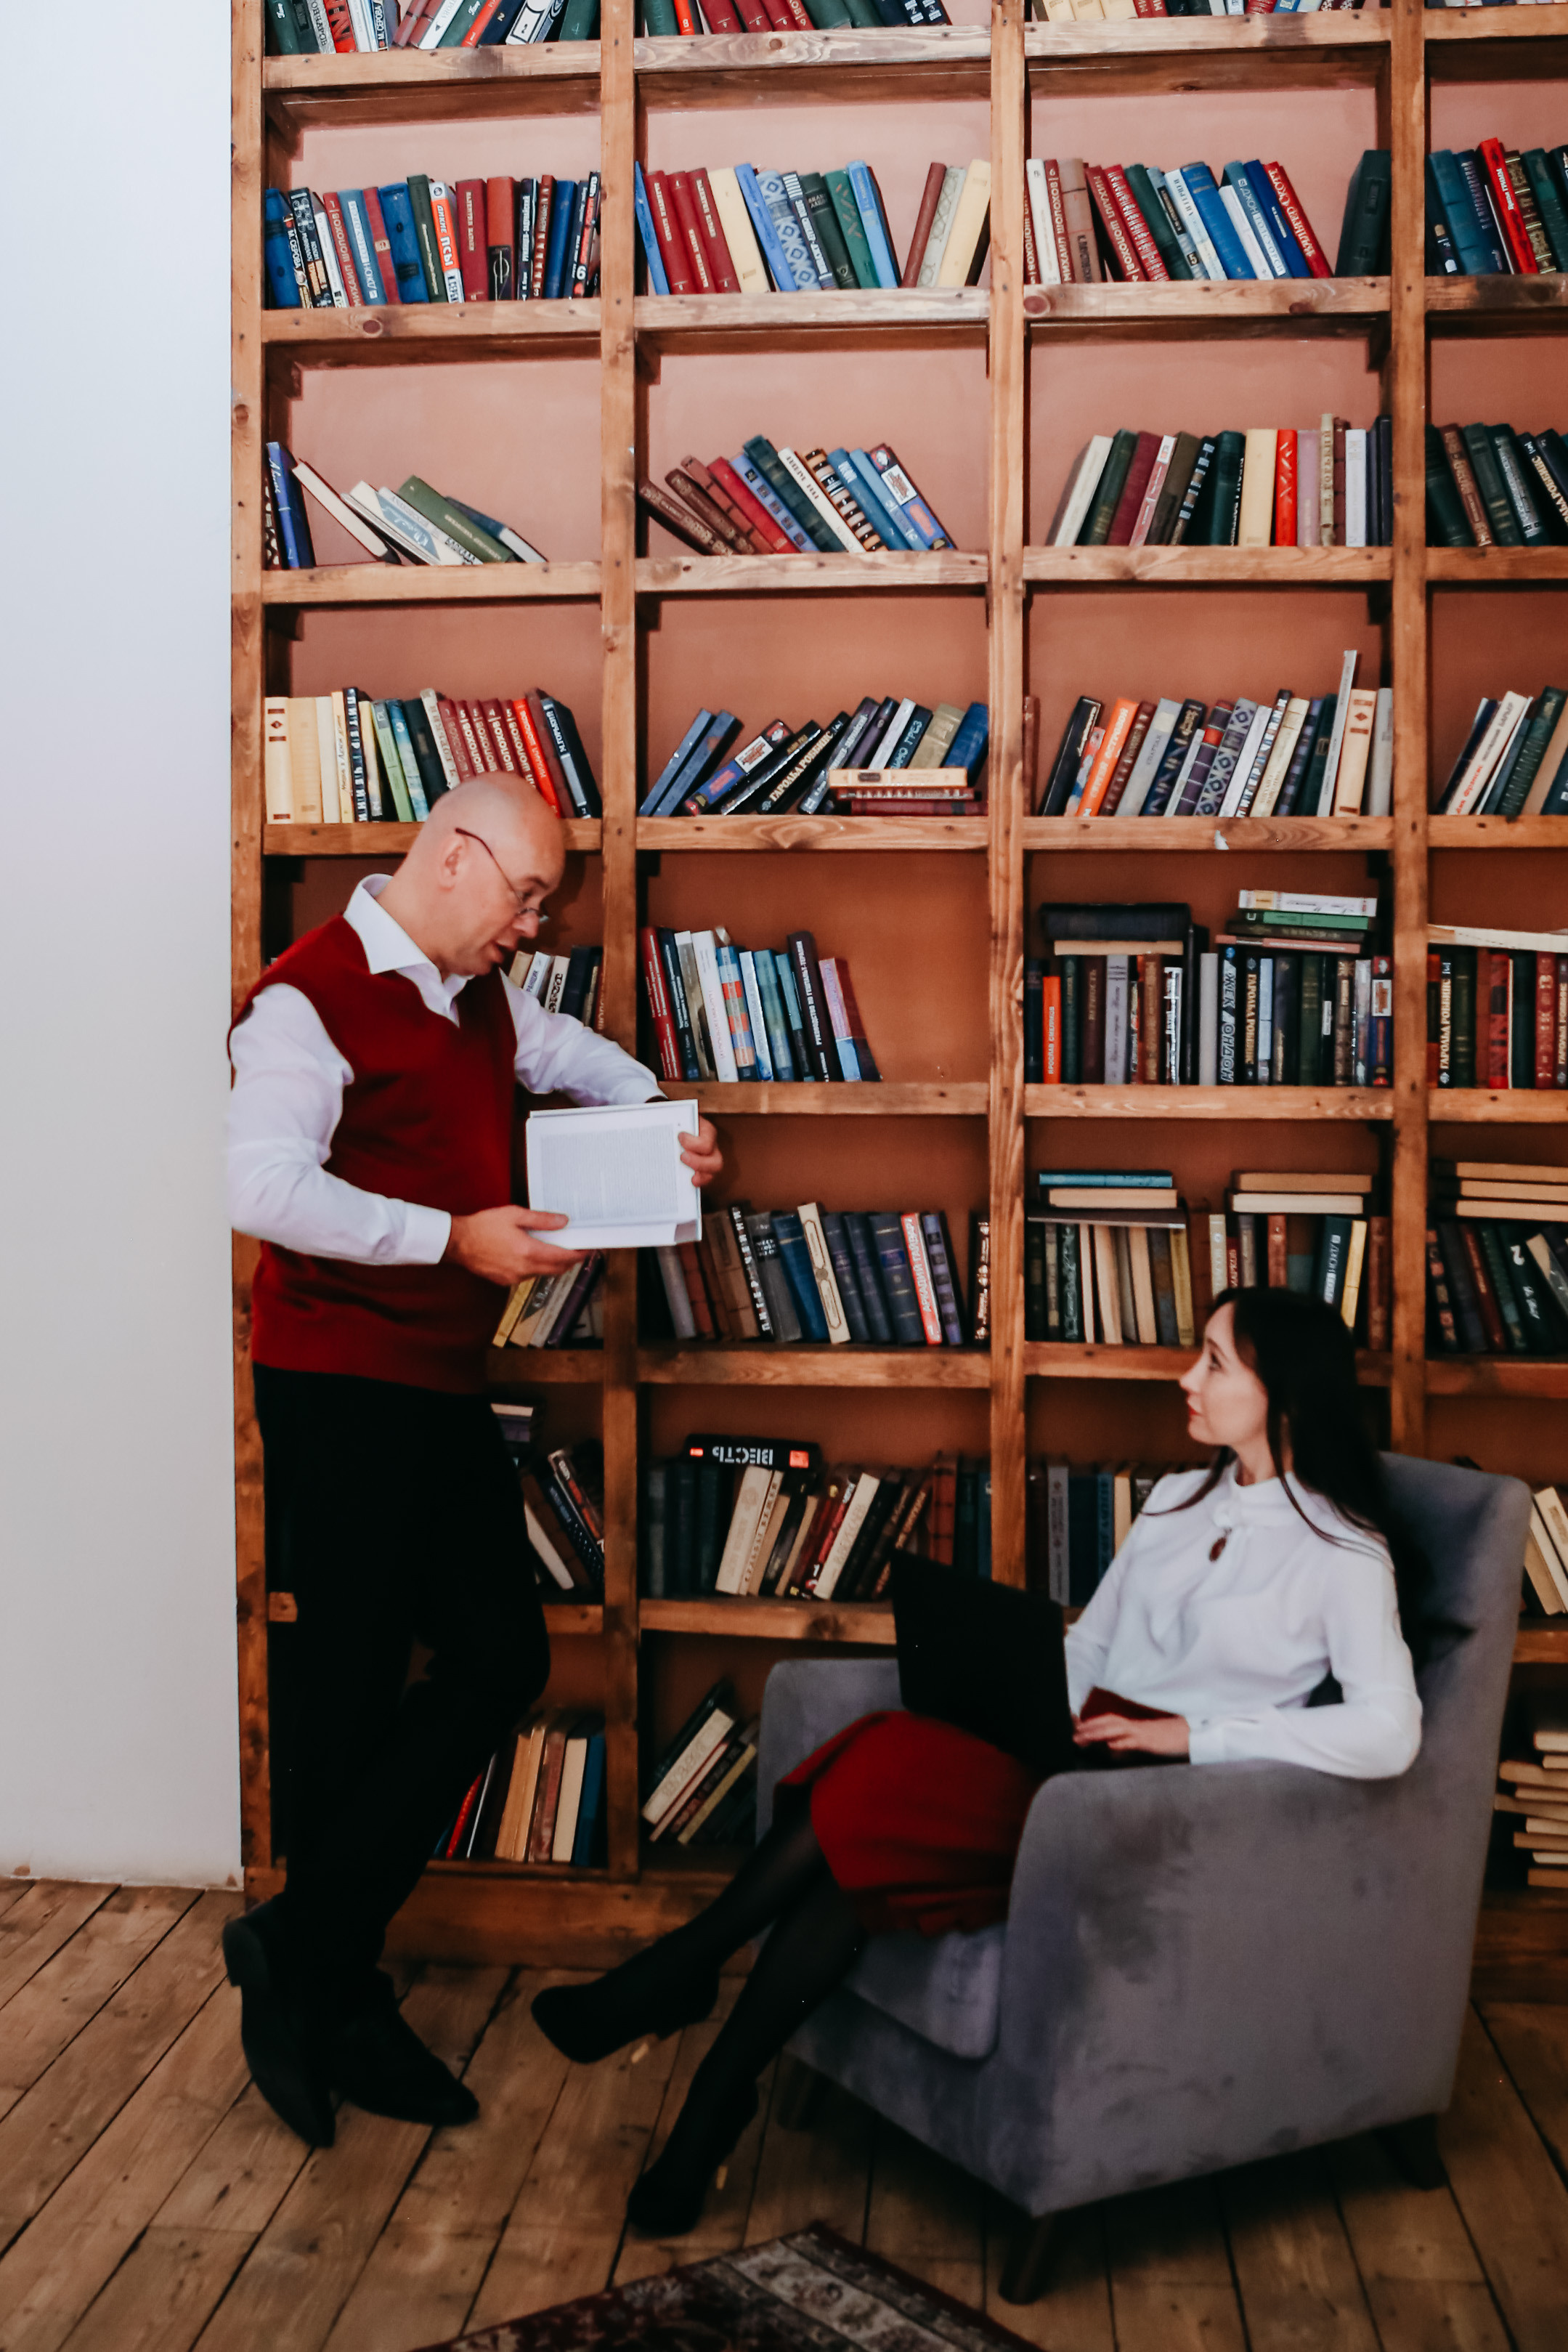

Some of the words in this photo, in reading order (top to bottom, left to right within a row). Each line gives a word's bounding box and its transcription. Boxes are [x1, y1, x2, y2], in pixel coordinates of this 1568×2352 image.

[375, 4, 386, 33] СЕРОВА
[436, 204, 447, 234] ДИКИЕ
[1050, 182, 1065, 234] ШОЛОХОВ
[1093, 174, 1116, 219] МИХАИЛ
[1110, 219, 1137, 271] ШОЛОХОВ
[1239, 187, 1259, 214] ДЖОН
[288, 239, 302, 269] СЕРОВА
[332, 213, 351, 262] ШОЛОХОВ
[439, 236, 454, 267] ПСЫ
[1058, 238, 1073, 283] МИХАИЛ
[344, 264, 362, 307] МИХАИЛ
[576, 265, 586, 280] 6
[1531, 455, 1557, 498] РОББИНС
[396, 721, 405, 733] 3
[463, 721, 485, 774] ШОЛОХОВ
[476, 721, 498, 773] ШОЛОХОВ
[492, 720, 515, 772] ШОЛОХОВ
[508, 719, 531, 772] ШОЛОХОВ
[768, 764, 803, 801] ГАРОЛЬД
[798, 729, 834, 770] РОББИНС
[1246, 973, 1257, 1021] ГАРОЛЬД
[1440, 978, 1451, 1025] РОББИНС
[1439, 1025, 1451, 1070] ГАРОЛЬД
[914, 1265, 933, 1313] АРКАДИЙ
